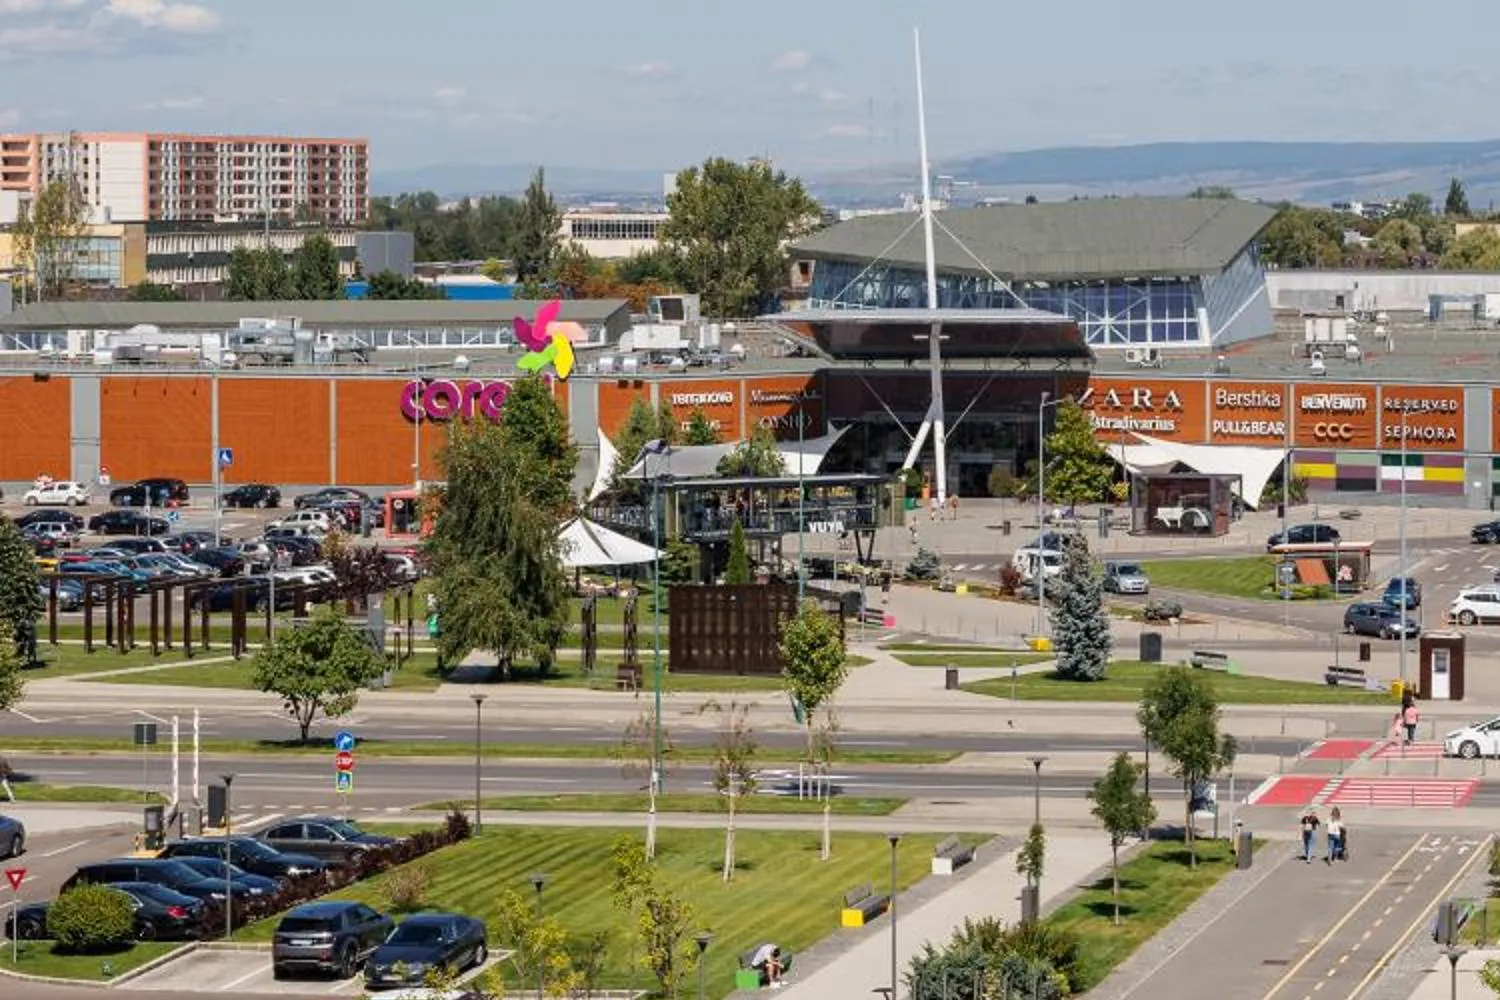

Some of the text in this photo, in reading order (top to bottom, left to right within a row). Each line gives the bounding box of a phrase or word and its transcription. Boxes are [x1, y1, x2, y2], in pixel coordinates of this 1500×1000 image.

[1077, 386, 1182, 409] ZARA
[1214, 388, 1281, 408] Bershka
[1384, 398, 1457, 411] RESERVED
[1213, 419, 1285, 434] PULL&BEAR
[1314, 422, 1352, 437] CCC
[1384, 426, 1456, 439] SEPHORA
